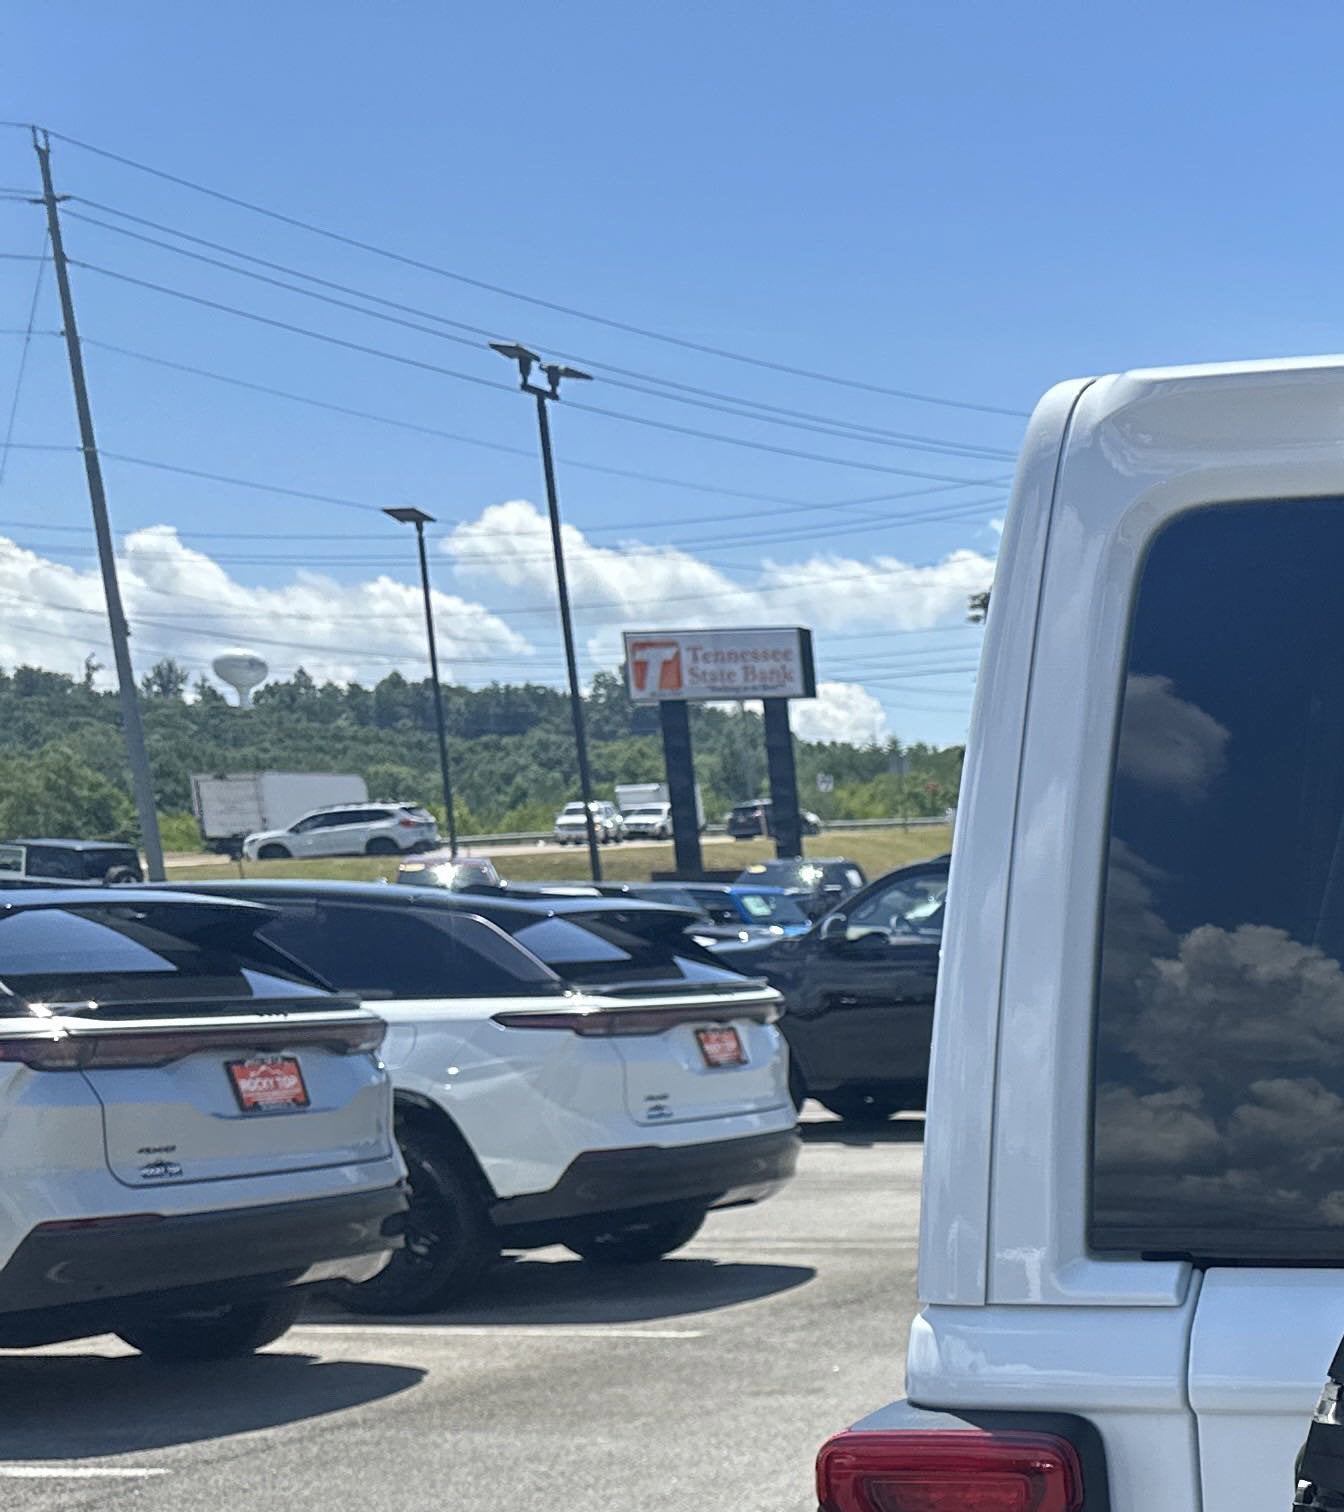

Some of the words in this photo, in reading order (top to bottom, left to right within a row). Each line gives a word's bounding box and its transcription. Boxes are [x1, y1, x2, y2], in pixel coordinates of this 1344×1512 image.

[686, 646, 795, 664] Tennessee
[688, 667, 737, 684] State
[743, 664, 794, 684] Bank
